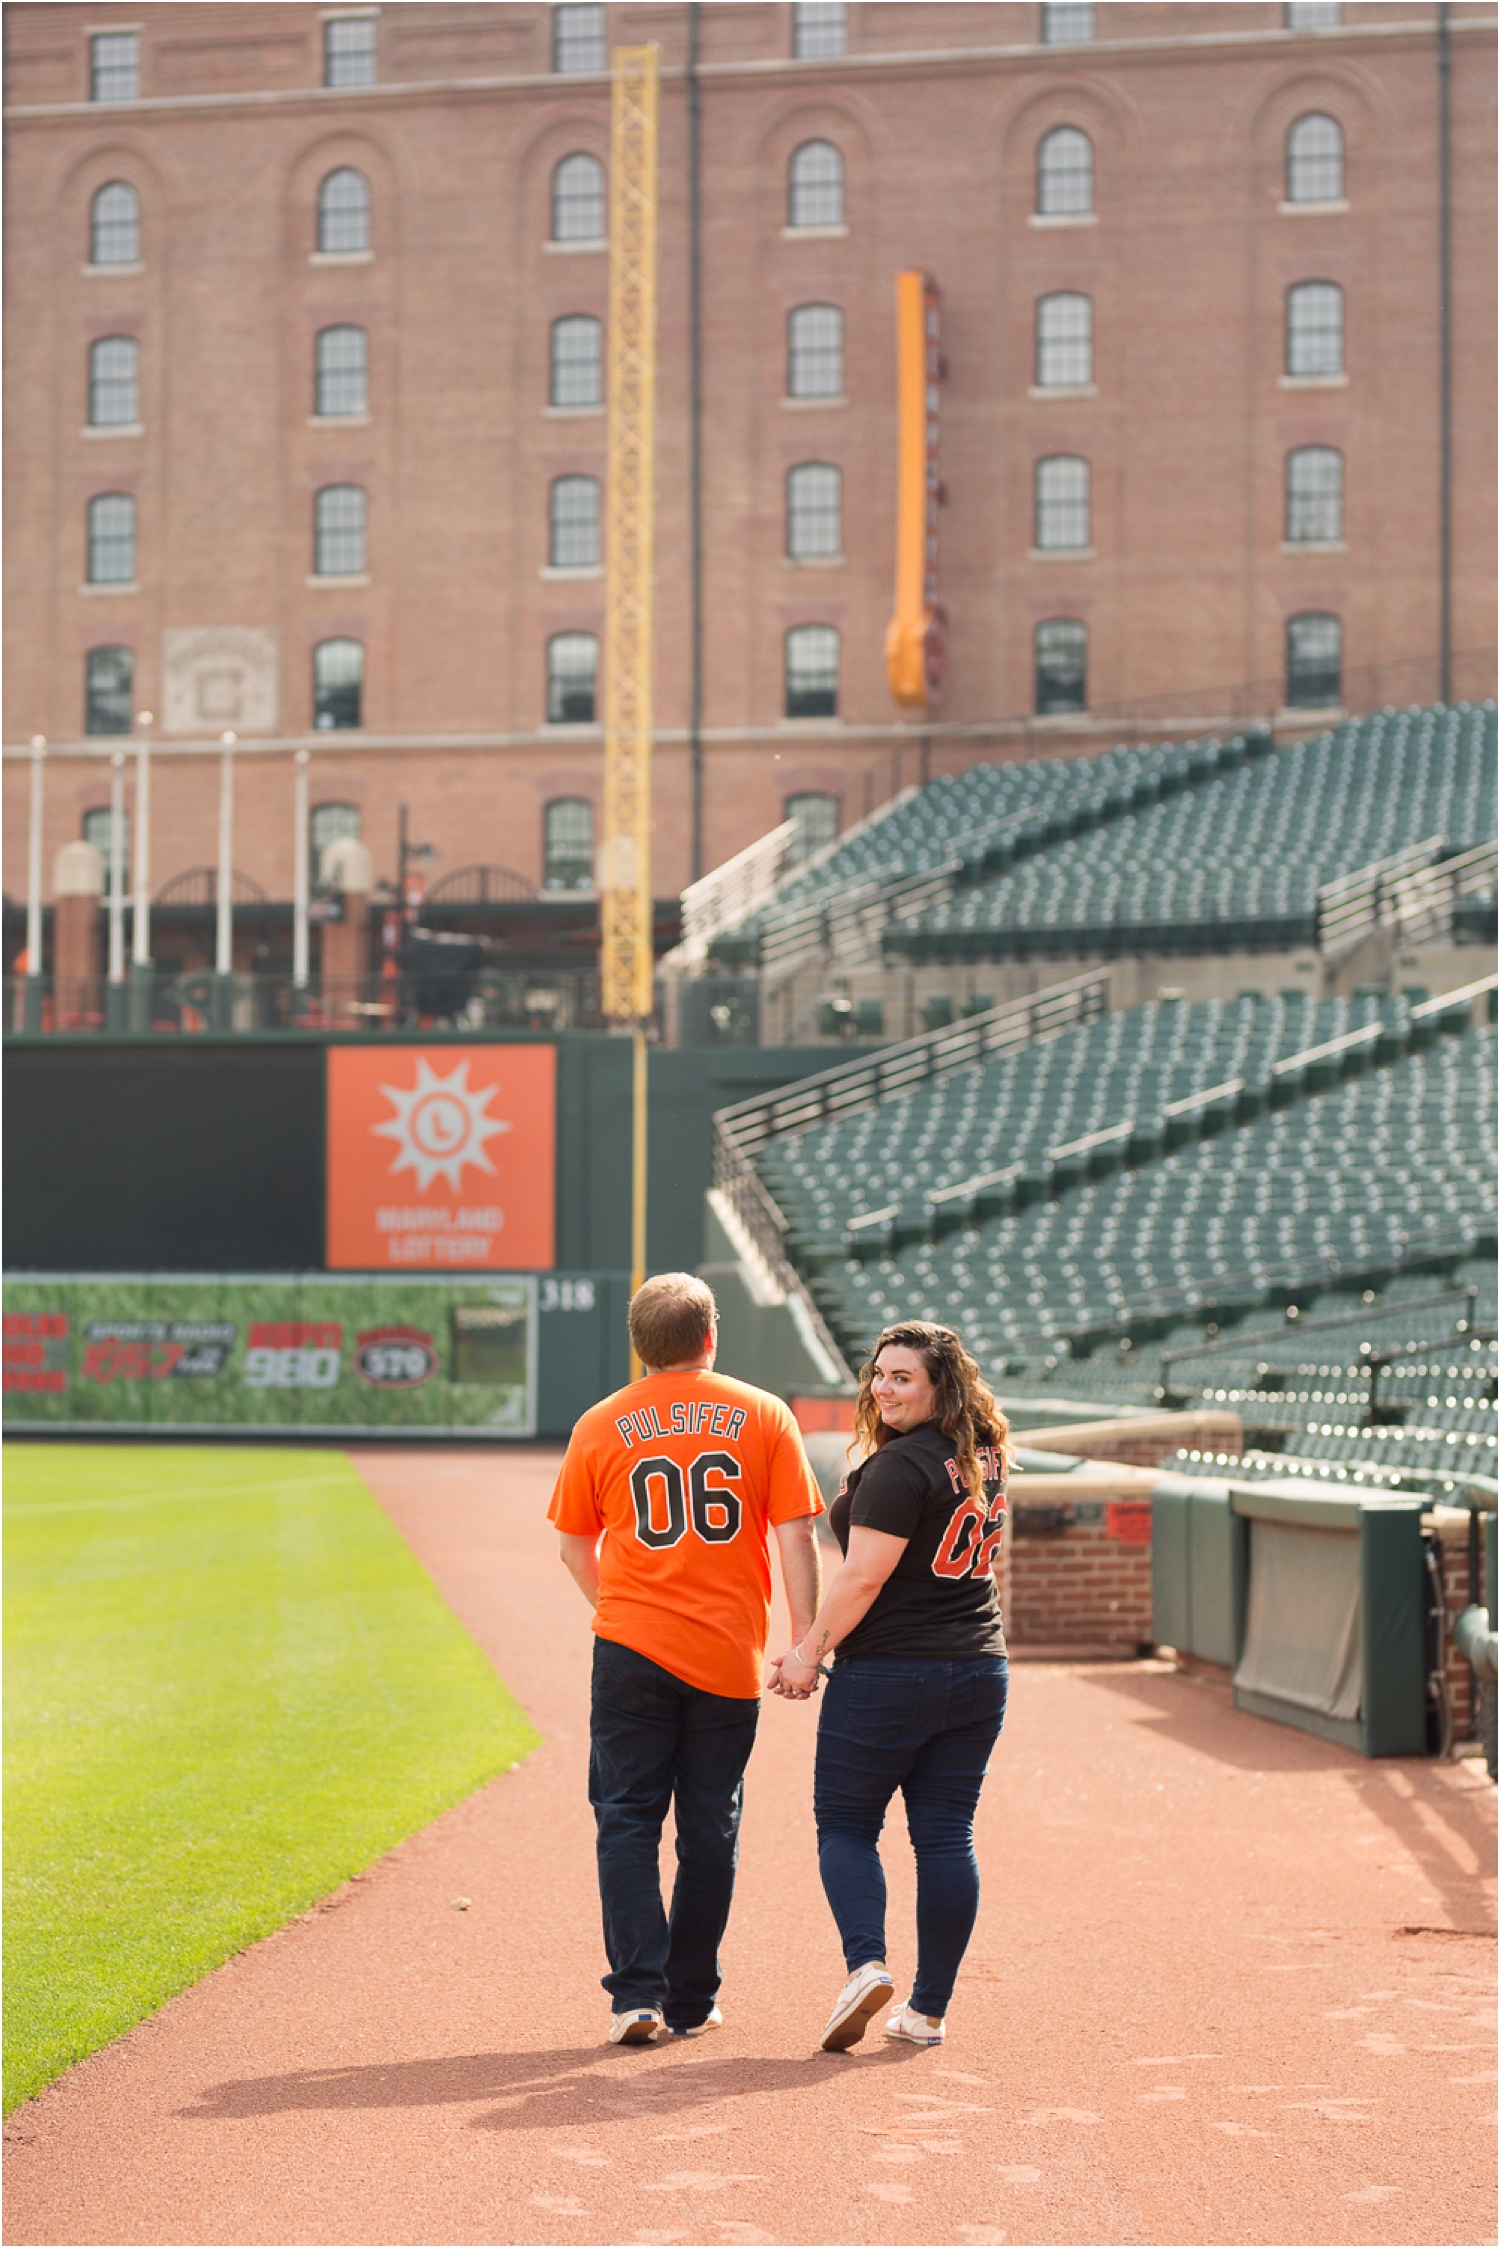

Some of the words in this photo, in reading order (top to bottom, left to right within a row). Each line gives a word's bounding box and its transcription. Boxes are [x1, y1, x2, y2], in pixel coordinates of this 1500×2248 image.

[376, 1206, 504, 1233] MARYLAND
[388, 1235, 494, 1262] LOTTERY
[541, 1279, 595, 1312] 318
[243, 1350, 341, 1388] 980
[615, 1402, 747, 1449] PULSIFER
[629, 1450, 742, 1551] 06
[931, 1493, 1007, 1579] 02
